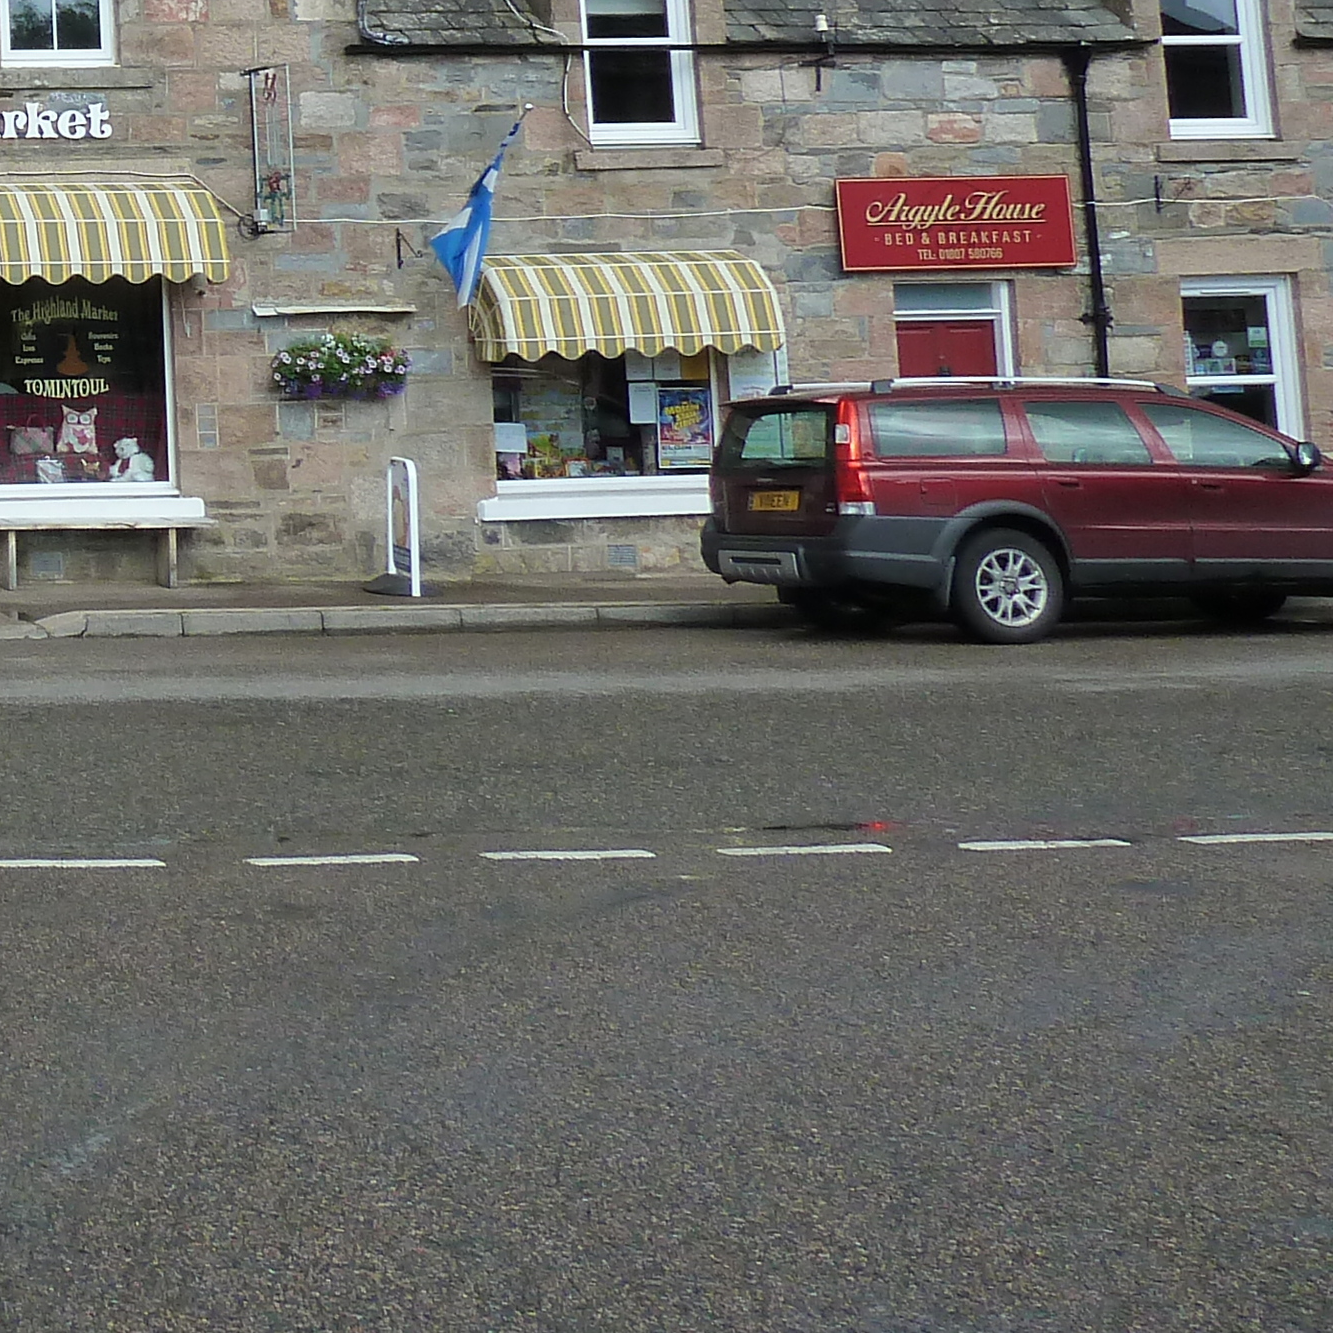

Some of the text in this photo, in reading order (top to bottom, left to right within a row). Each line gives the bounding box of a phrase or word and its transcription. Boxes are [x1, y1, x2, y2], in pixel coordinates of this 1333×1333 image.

[866, 190, 1046, 230] Argyle House
[885, 231, 1032, 245] BED & BREAKFAST
[11, 296, 118, 324] The Highland Market
[24, 378, 109, 399] TOMINTOUL
